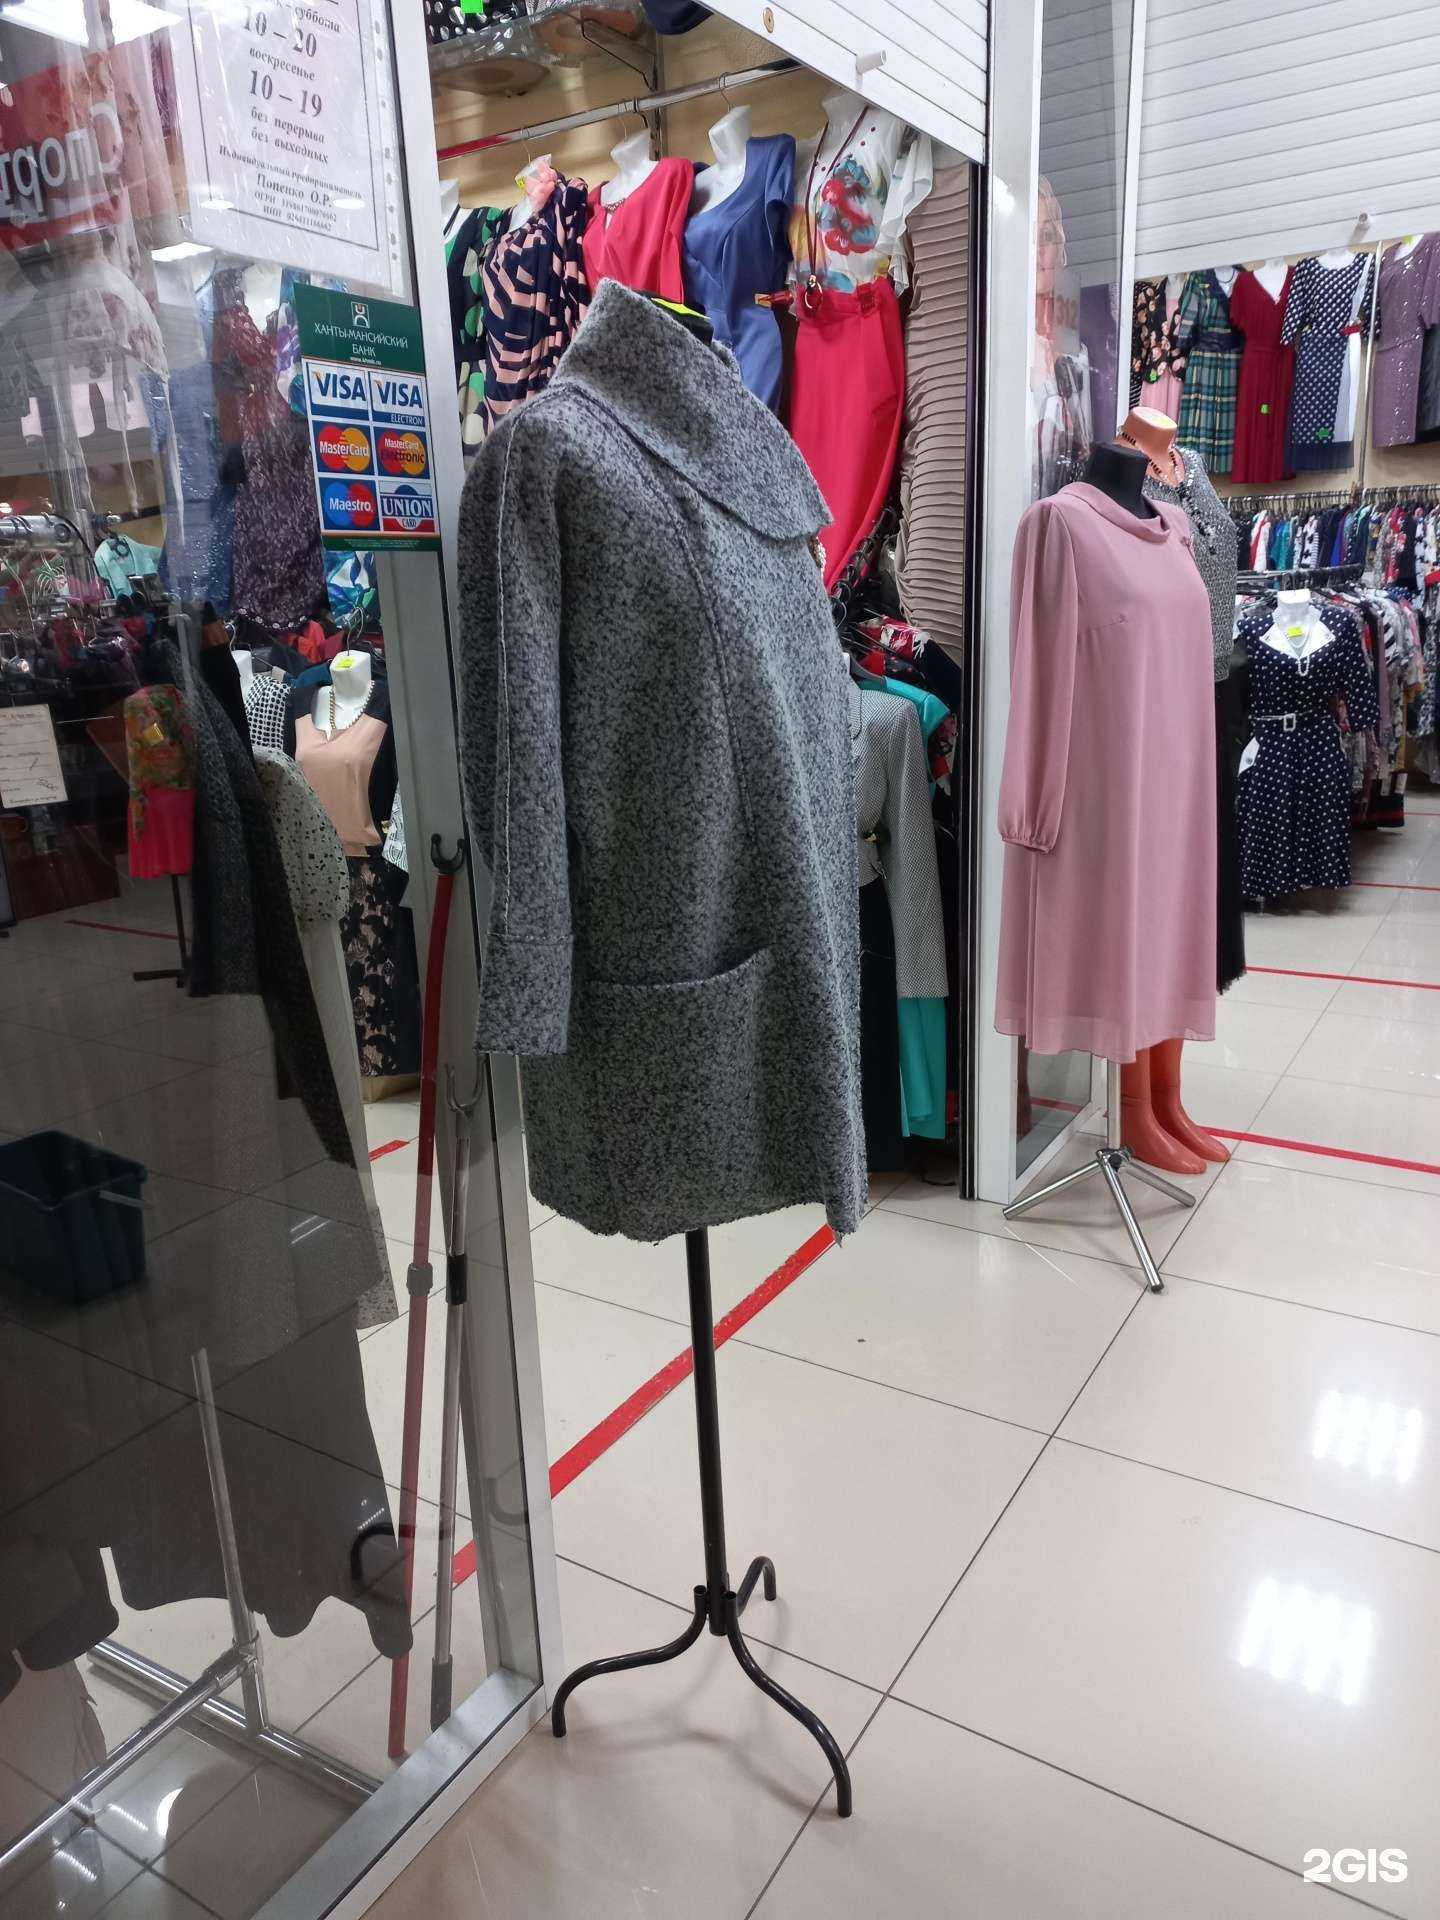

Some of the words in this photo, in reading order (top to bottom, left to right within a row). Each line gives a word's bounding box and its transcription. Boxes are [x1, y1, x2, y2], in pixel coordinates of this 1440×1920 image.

[295, 5, 340, 33] суббота
[249, 47, 315, 81] воскресенье
[249, 70, 273, 100] 10
[300, 89, 323, 118] 19
[251, 106, 268, 123] без
[274, 117, 325, 144] перерыва
[251, 127, 268, 143] без
[274, 138, 329, 164] выходных
[314, 322, 409, 349] ХАНТЫ-МАНСИЙСКИЙ
[352, 343, 376, 358] БАНК
[316, 371, 367, 402] VISA
[376, 378, 423, 409] VISA
[390, 414, 423, 426] ELECTRON
[319, 439, 369, 458] MasterCard
[384, 437, 419, 450] MasterCard
[329, 496, 373, 513] Maestro
[382, 496, 433, 518] UNION
[401, 518, 417, 529] CARD
